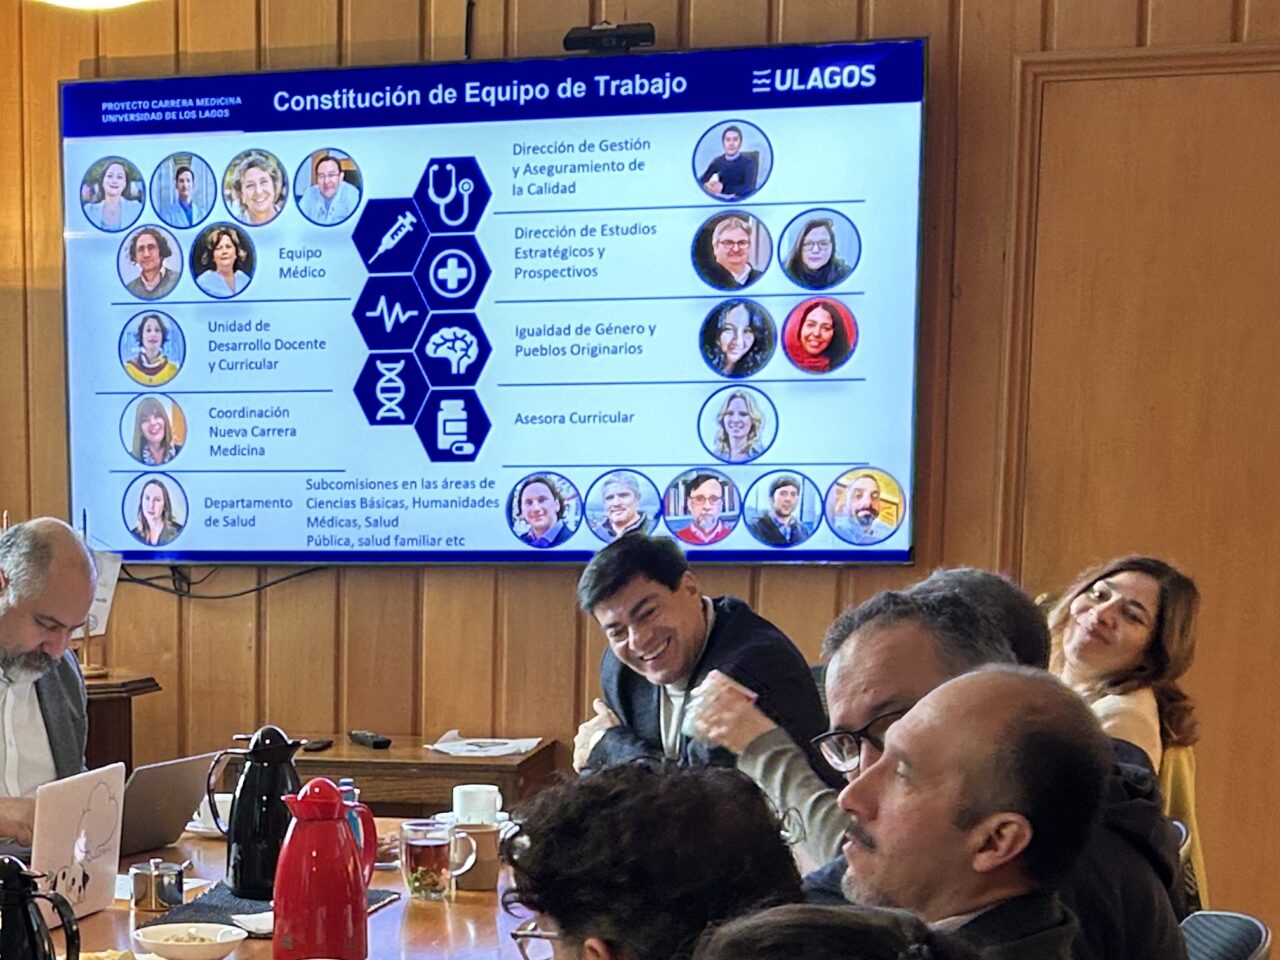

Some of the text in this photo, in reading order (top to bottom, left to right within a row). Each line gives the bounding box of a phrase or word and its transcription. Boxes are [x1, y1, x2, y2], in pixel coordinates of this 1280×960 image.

[775, 64, 876, 90] ULAGOS
[273, 72, 687, 112] Constitución de Equipo de Trabajo
[102, 97, 242, 111] PROYECTO CARRERA MEDICINA
[102, 109, 229, 122] UNIVERSIDAD DE LOS LAGOS
[512, 137, 651, 155] Dirección de Gestión
[512, 158, 645, 177] y Aseguramiento de
[512, 181, 576, 196] la Calidad
[514, 221, 657, 239] Dirección de Estudios
[279, 247, 323, 264] Equipo
[514, 245, 605, 262] Estratégicos y
[279, 266, 326, 280] Médico
[514, 264, 598, 281] Prospectivos
[208, 320, 270, 333] Unidad de
[515, 321, 656, 339] Igualdad de Género y
[208, 338, 326, 353] Desarrollo Docente
[515, 341, 643, 358] Pueblos Originarios
[208, 358, 279, 373] y Curricular
[209, 405, 290, 419] Coordinación
[514, 410, 635, 425] Asesora Curricular
[209, 425, 297, 438] Nueva Carrera
[210, 443, 265, 457] Medicina
[305, 477, 496, 491] Subcomisiones en las áreas de
[205, 496, 293, 512] Departamento
[306, 495, 500, 512] Ciencias Básicas, Humanidades
[205, 514, 255, 528] de Salud
[307, 514, 399, 531] Médicas, Salud
[306, 533, 465, 549] Pública, salud familiar etc
